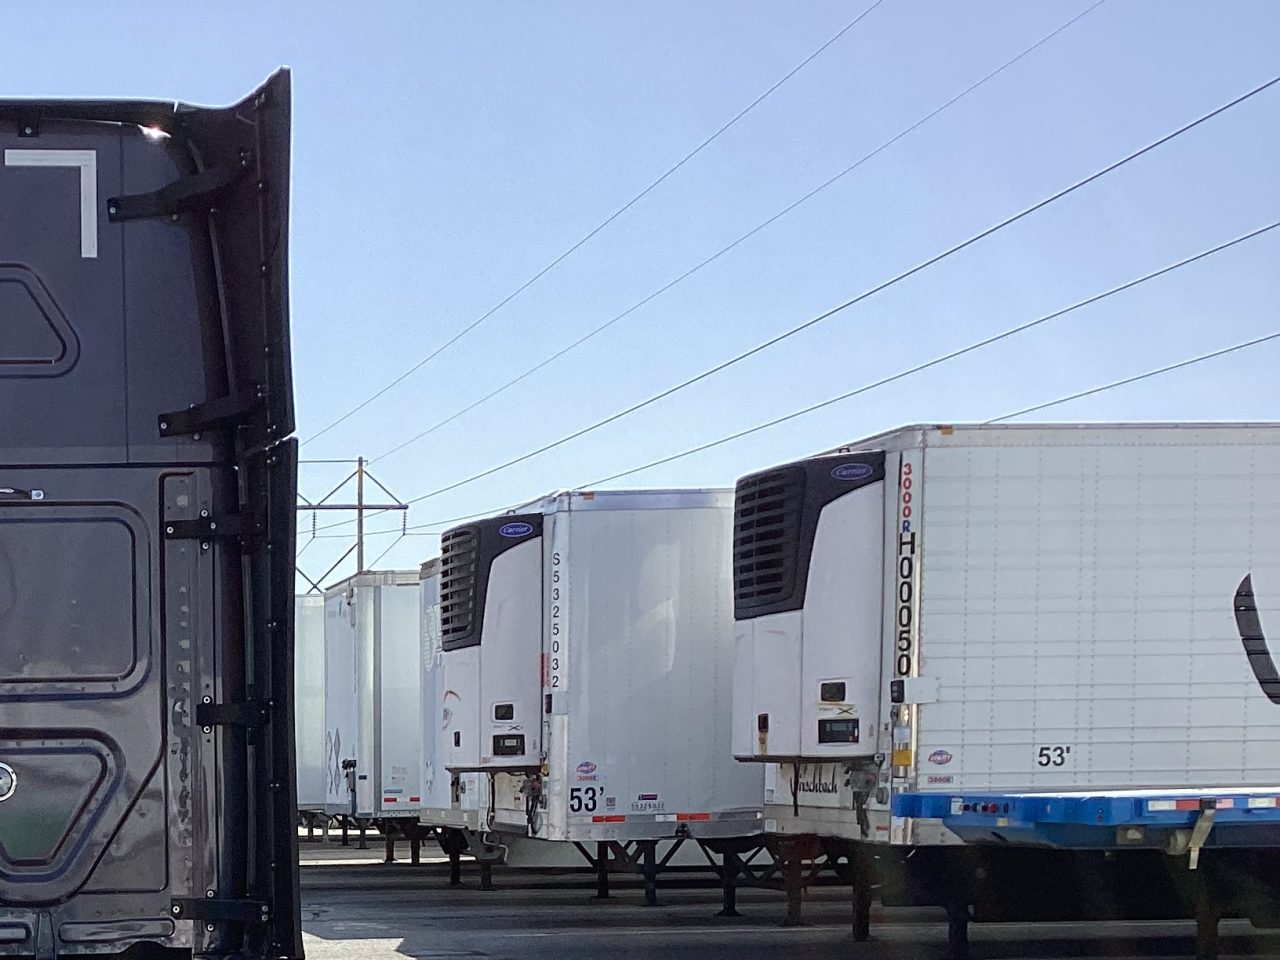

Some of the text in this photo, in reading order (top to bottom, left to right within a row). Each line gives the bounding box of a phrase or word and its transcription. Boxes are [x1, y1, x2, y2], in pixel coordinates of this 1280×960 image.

[835, 467, 867, 477] Carrier
[902, 462, 913, 533] 3000R
[502, 525, 529, 534] Carrier
[552, 552, 561, 688] S5325032
[897, 531, 916, 676] H00050
[1037, 746, 1071, 767] 53'
